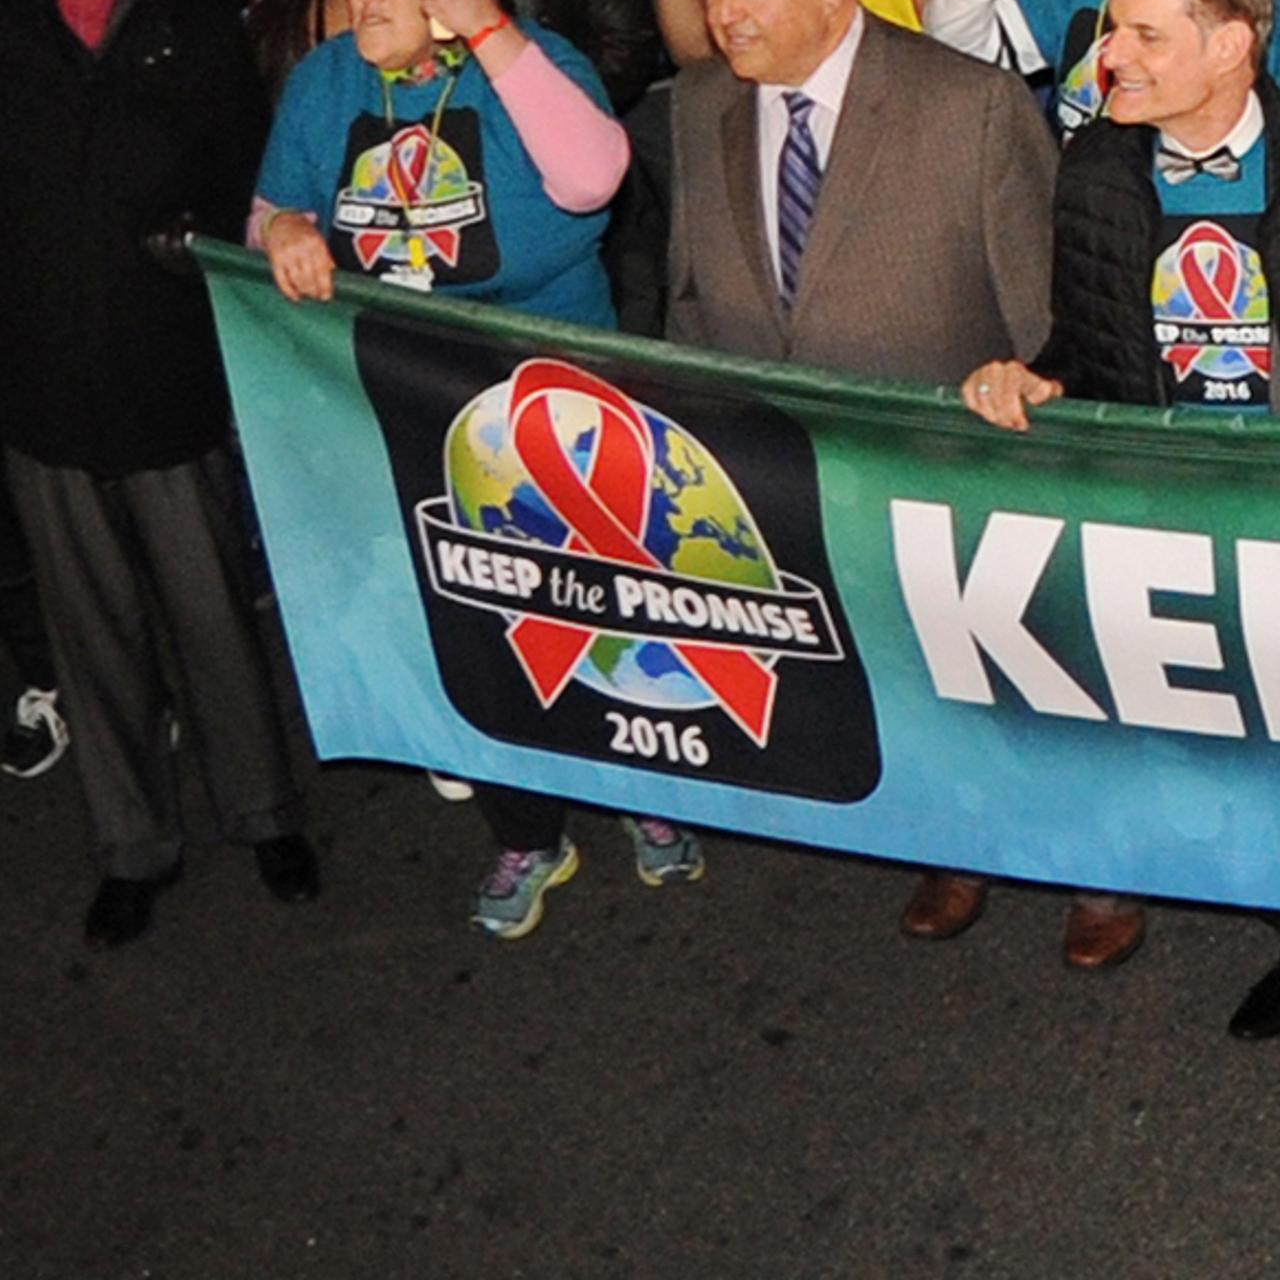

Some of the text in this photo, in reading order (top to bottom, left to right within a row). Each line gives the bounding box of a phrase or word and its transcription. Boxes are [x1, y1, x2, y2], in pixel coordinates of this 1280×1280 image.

[1203, 380, 1251, 402] 2016
[436, 539, 821, 646] KEEP the PROMISE
[603, 710, 712, 767] 2016
